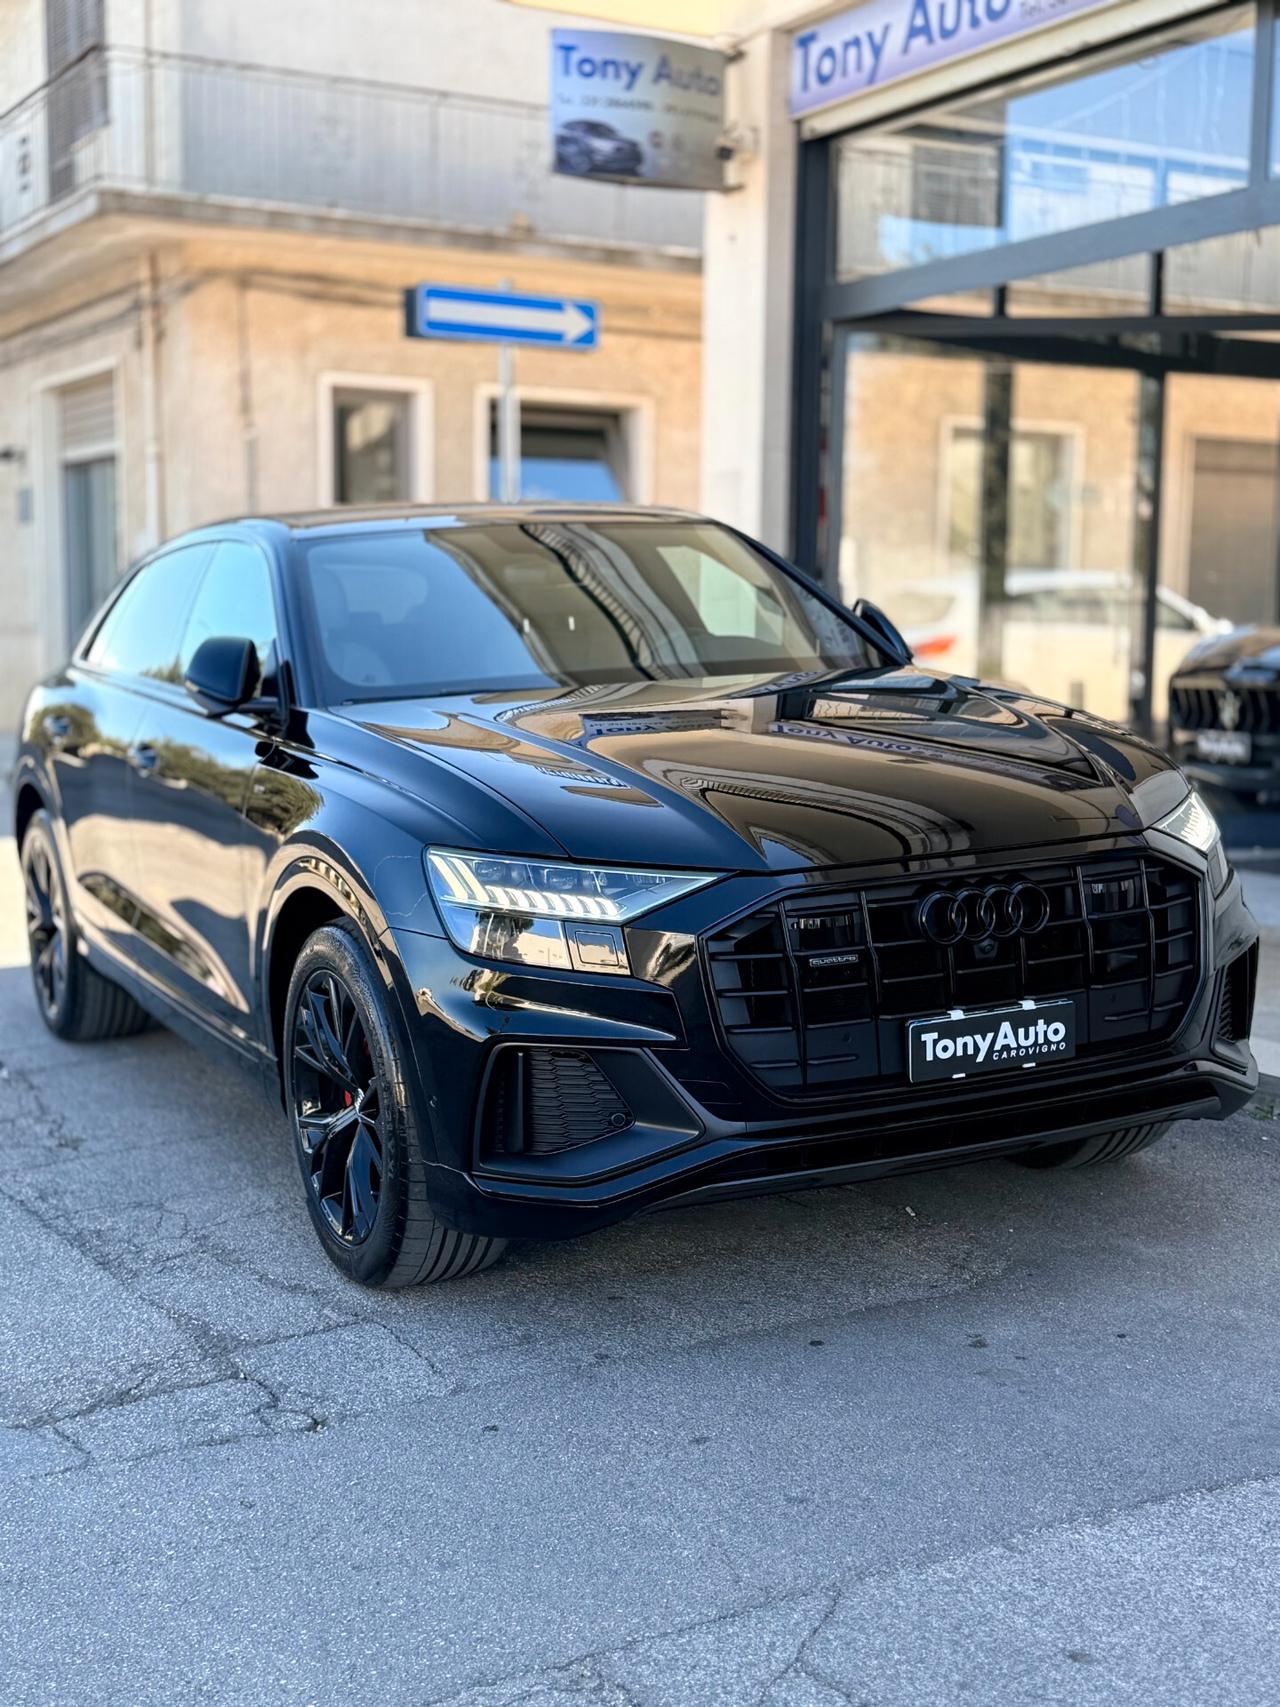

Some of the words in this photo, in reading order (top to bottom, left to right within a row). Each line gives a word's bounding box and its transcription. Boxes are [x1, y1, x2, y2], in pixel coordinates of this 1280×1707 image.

[557, 44, 644, 92] Tony
[653, 54, 720, 97] Auto
[795, 23, 890, 94] Tony
[812, 956, 856, 966] quattro
[921, 1018, 1067, 1063] TonyAuto
[993, 1041, 1067, 1061] CAROVIGNO
